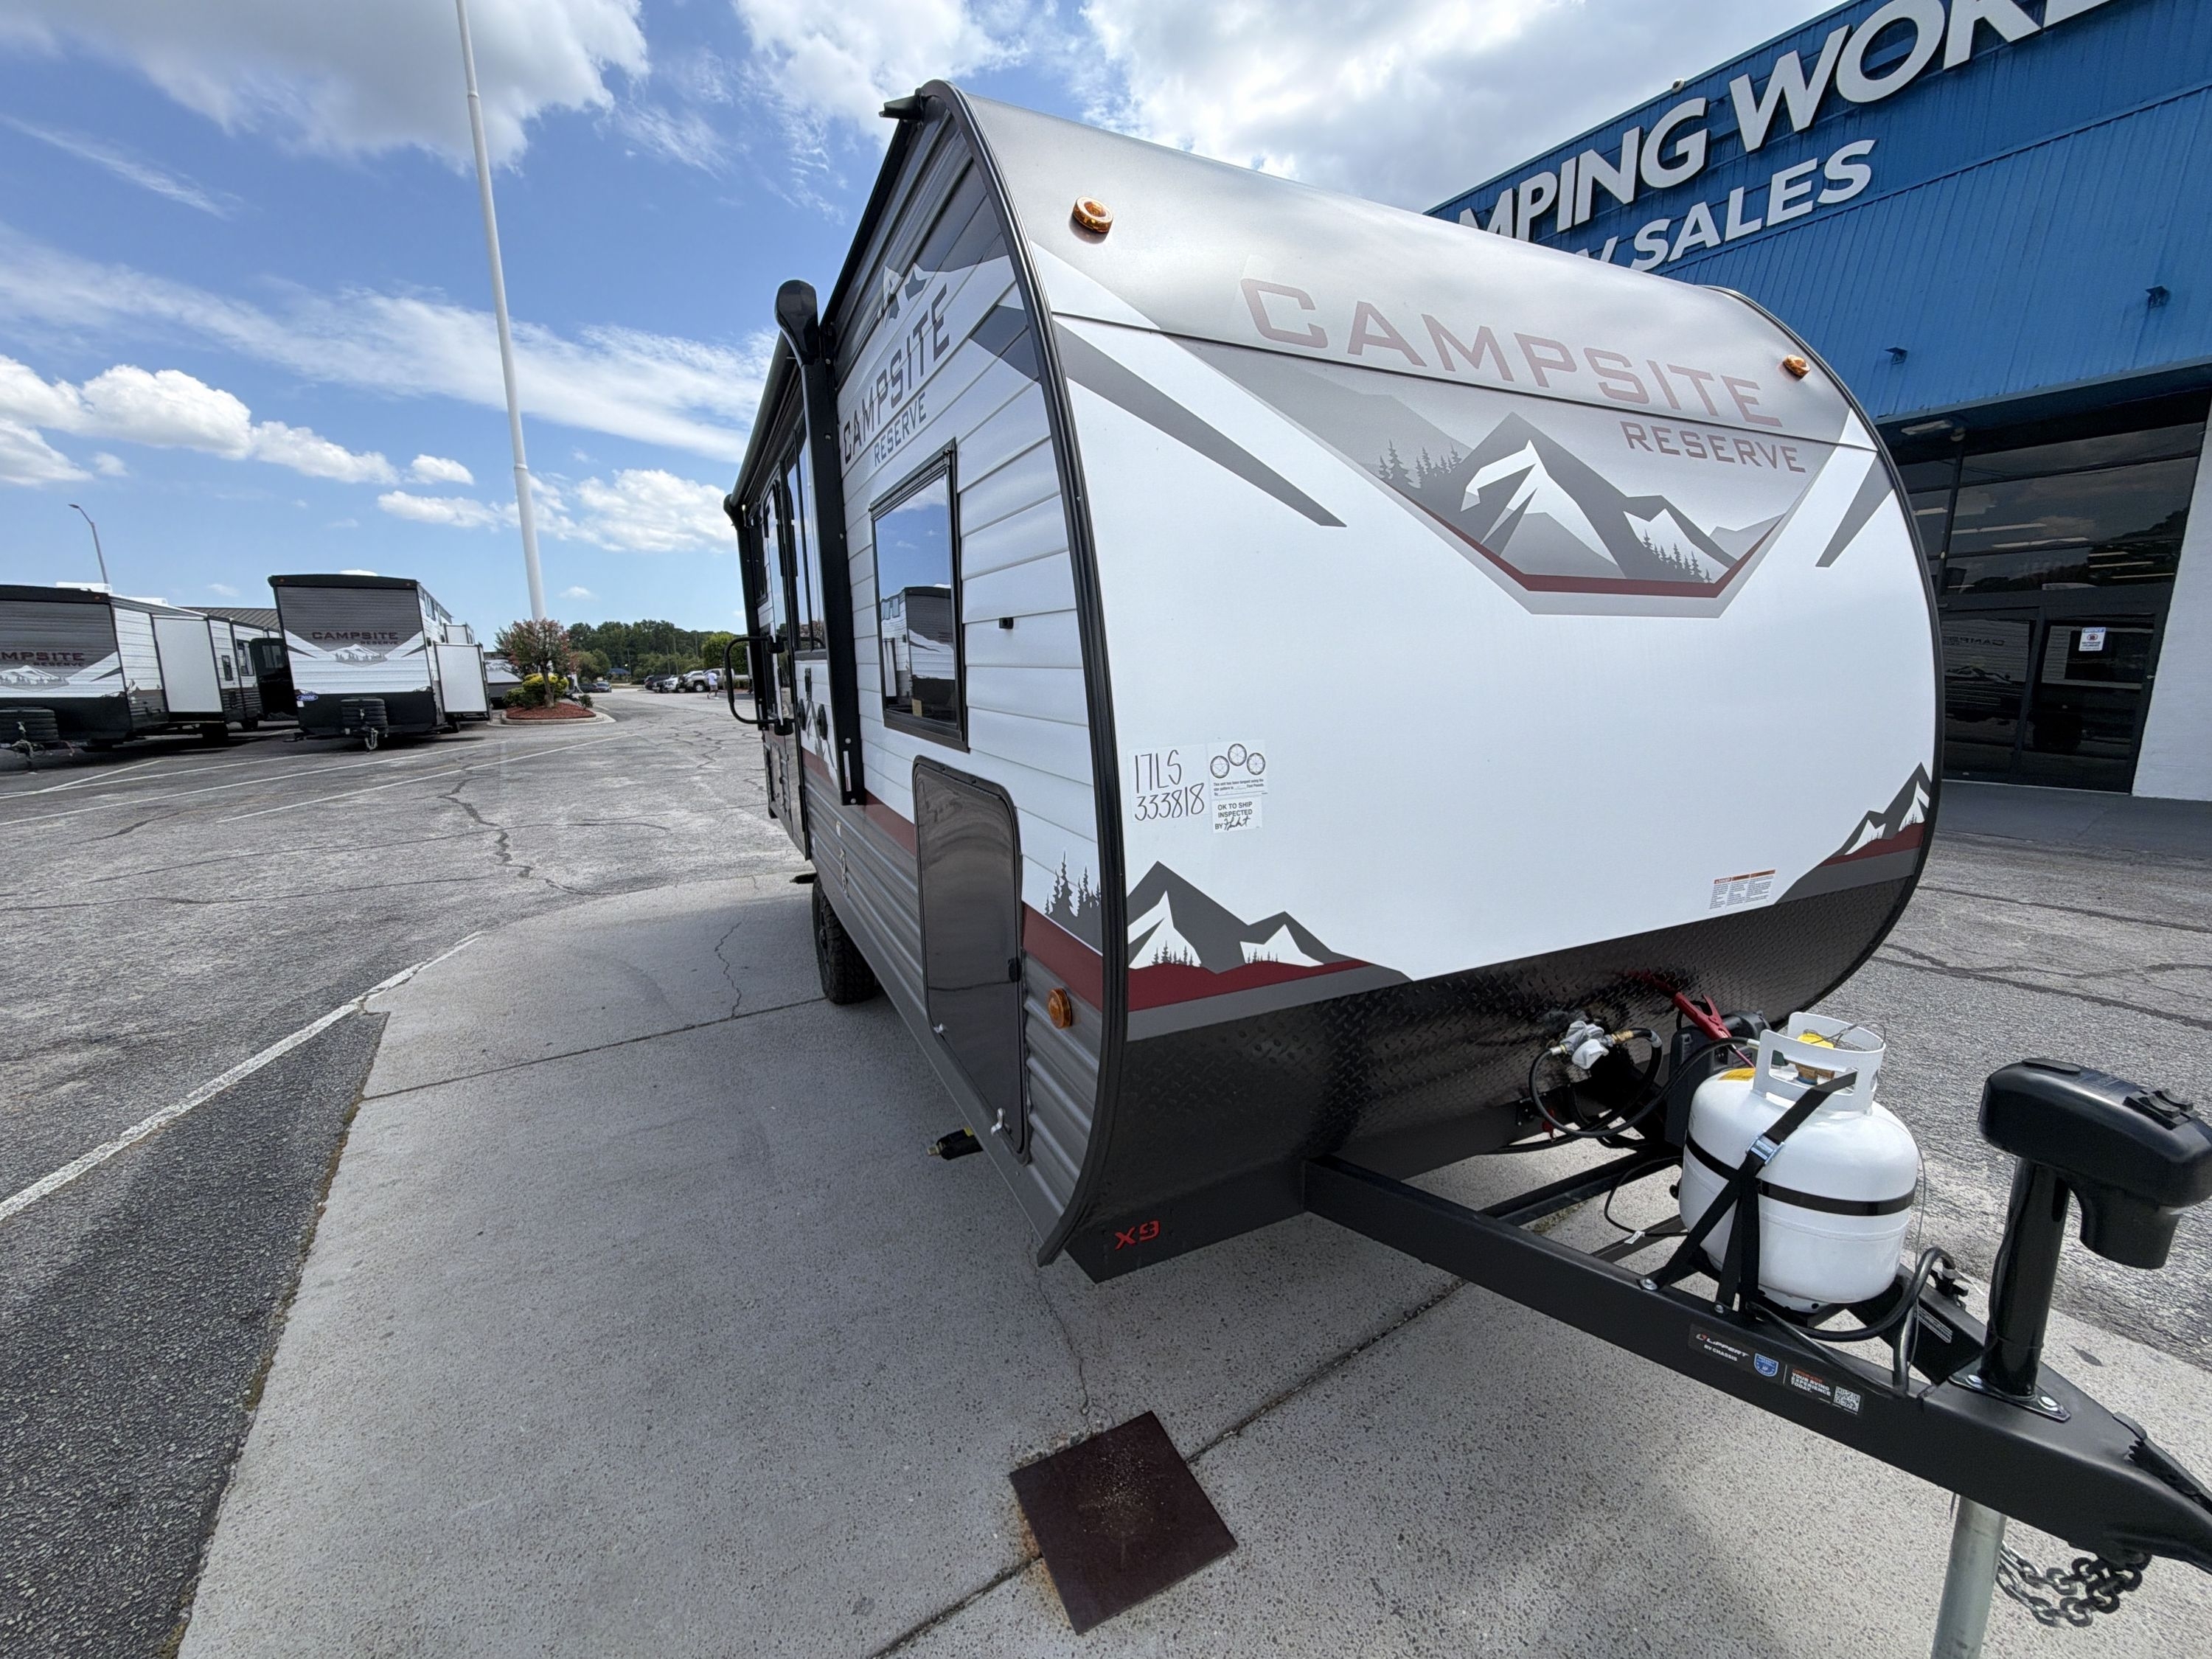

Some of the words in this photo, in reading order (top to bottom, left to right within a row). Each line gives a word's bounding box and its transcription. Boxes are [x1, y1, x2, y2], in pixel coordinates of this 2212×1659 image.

[1630, 139, 1876, 271] SALES
[1242, 279, 1782, 427] CAMPSITE
[844, 283, 950, 465] CAMPSITE
[874, 392, 926, 467] RESERVE
[1620, 422, 1806, 473] RESERVE
[312, 631, 399, 640] CAMPSITE
[1134, 782, 1205, 821] 333818
[1217, 809, 1253, 818] INSPECTED
[1214, 822, 1223, 830] BY
[1114, 1220, 1161, 1251] X9
[1712, 1348, 1738, 1362] CHASSIS
[1791, 1376, 1832, 1397] EXPERIENCE
[1792, 1372, 1809, 1382] YOUR
